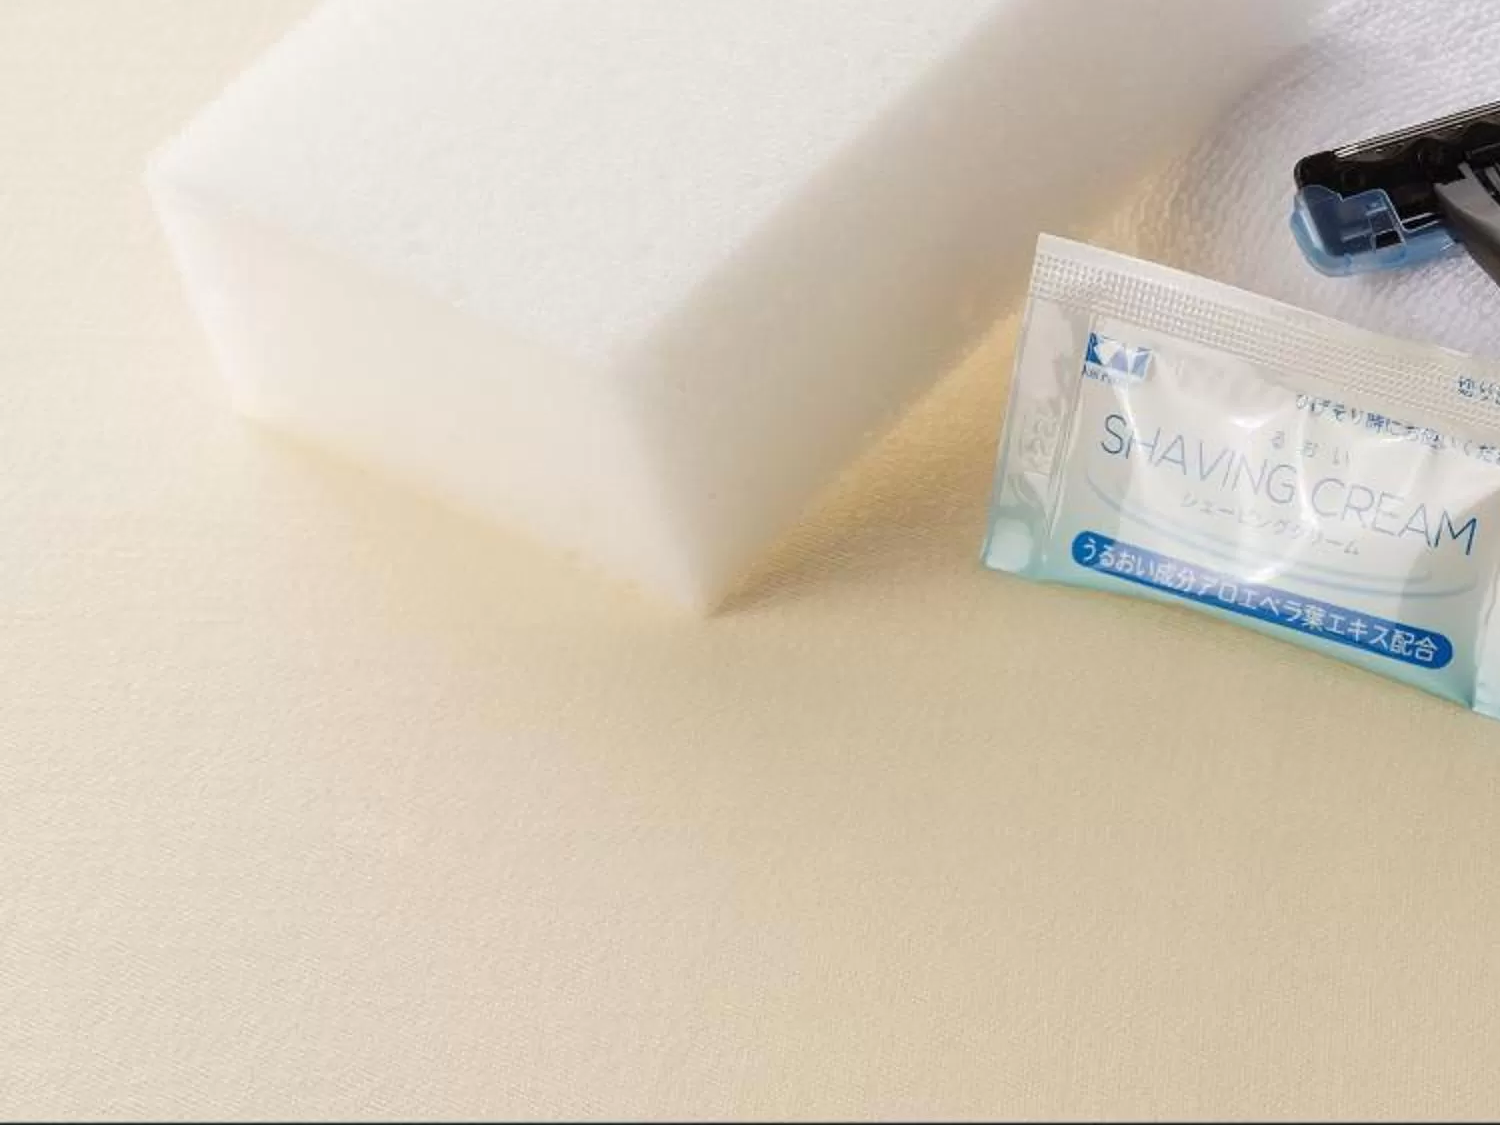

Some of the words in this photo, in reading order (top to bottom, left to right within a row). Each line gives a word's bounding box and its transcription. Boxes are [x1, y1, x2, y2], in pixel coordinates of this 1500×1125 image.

[1100, 413, 1297, 505] SHAVING
[1311, 477, 1477, 556] CREAM
[1083, 537, 1440, 663] うるおい成分アロエベラ葉エキス配合
